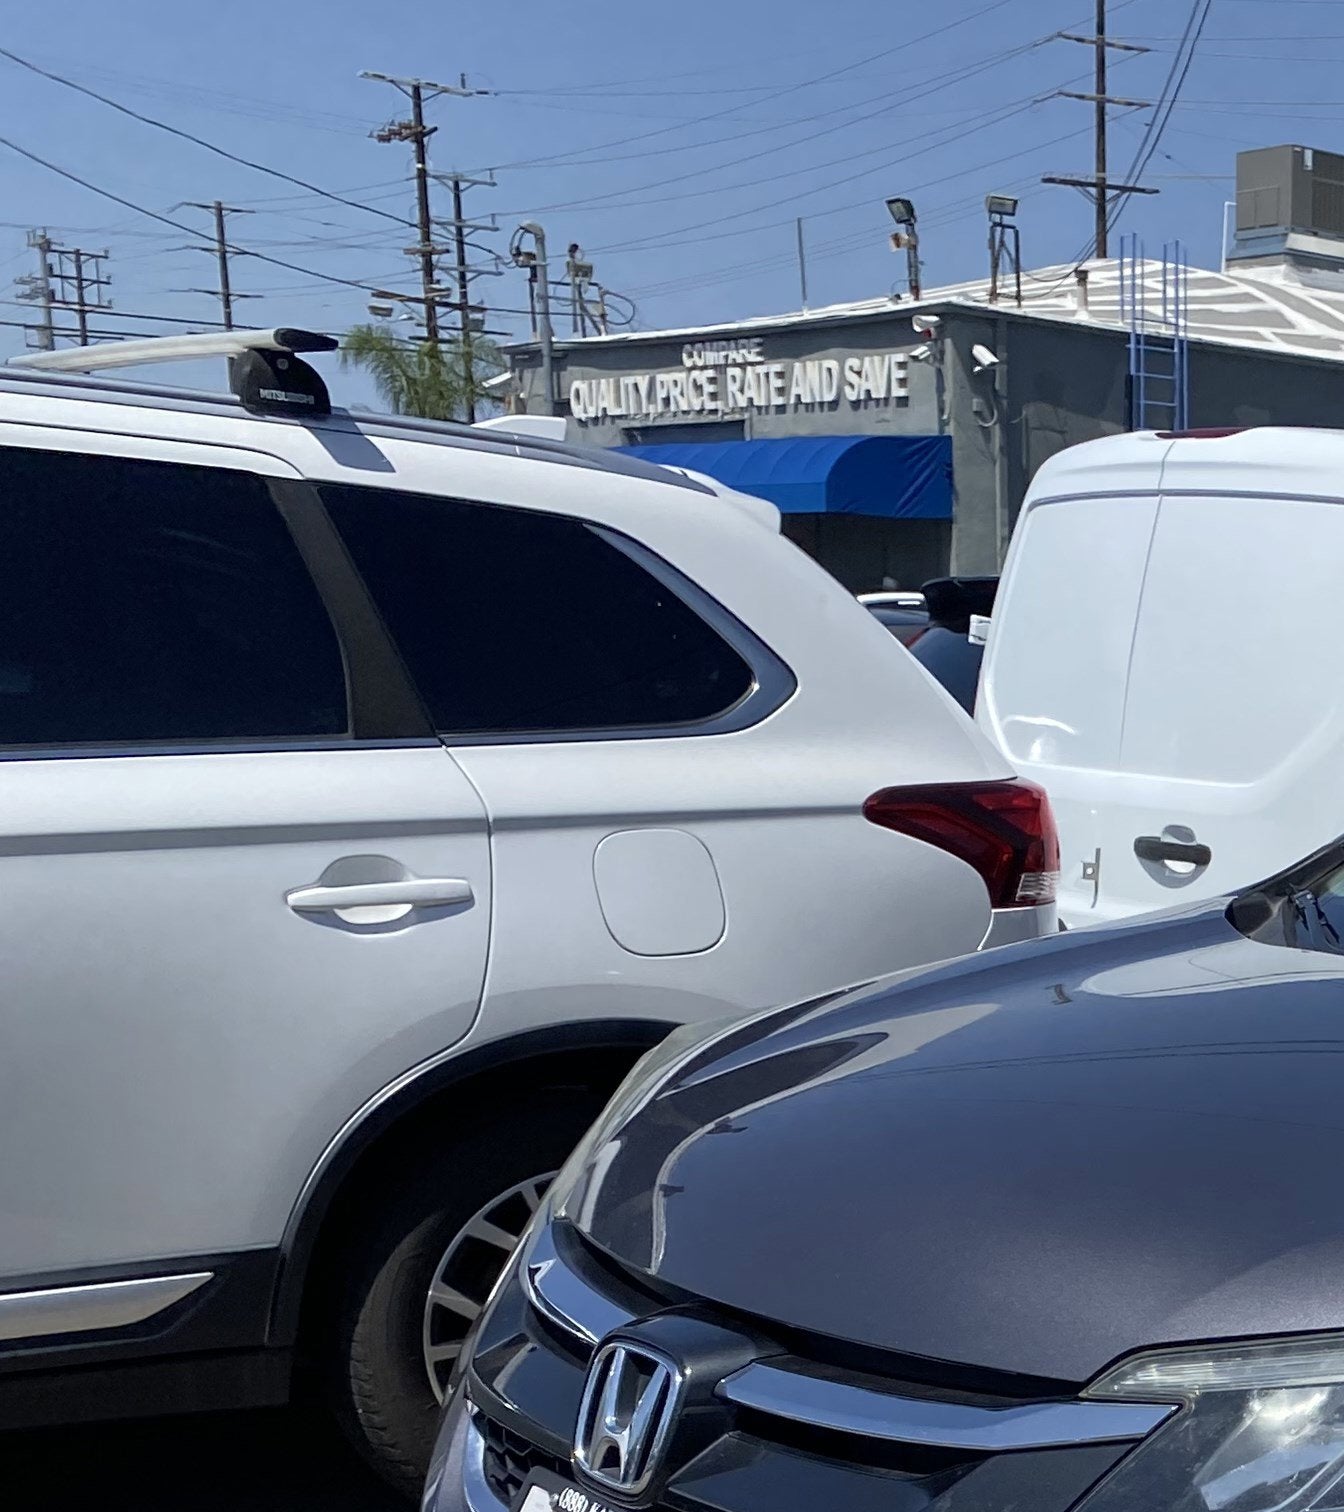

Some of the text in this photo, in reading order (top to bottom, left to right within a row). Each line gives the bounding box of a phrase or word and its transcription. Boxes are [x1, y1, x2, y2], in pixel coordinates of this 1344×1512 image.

[726, 363, 786, 408] RATE
[789, 359, 840, 404] AND
[844, 353, 909, 400] SAVE
